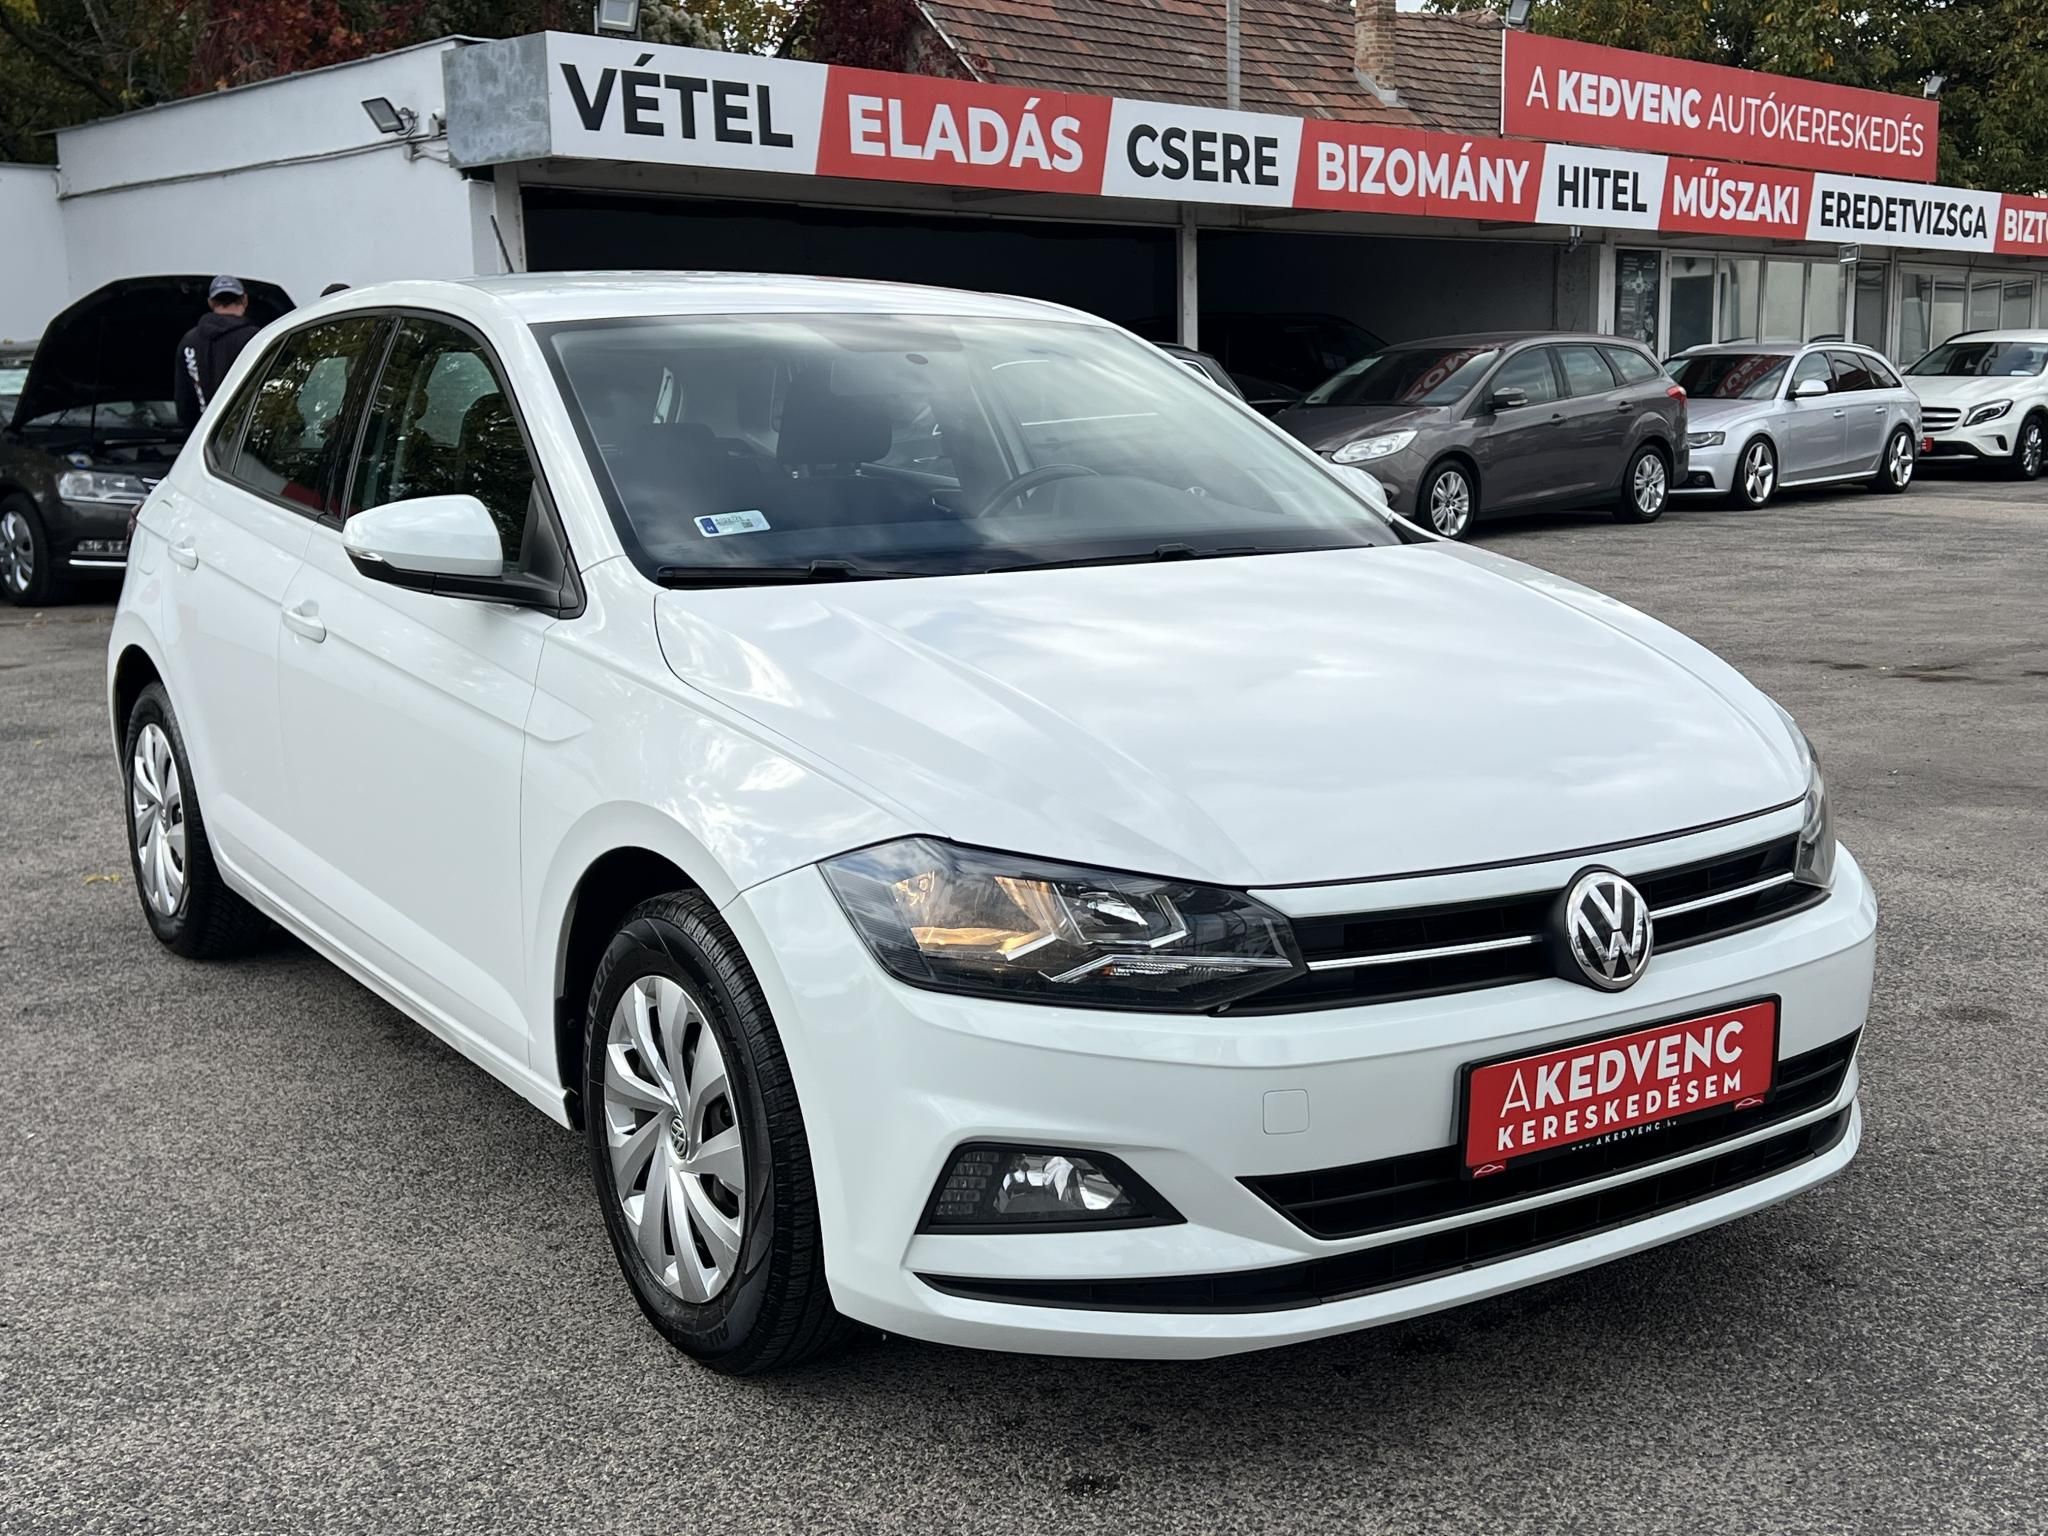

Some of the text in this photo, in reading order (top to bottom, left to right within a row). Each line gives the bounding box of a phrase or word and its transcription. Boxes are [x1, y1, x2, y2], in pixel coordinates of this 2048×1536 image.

[561, 54, 793, 148] VÉTEL
[1526, 66, 1923, 157] A KEDVENC AUTÓKERESKEDÉS
[848, 94, 1083, 172] ELADÁS
[1127, 125, 1278, 186] CSERE
[1318, 142, 1529, 204] BIZOMÁNY
[1558, 165, 1647, 212] HITEL
[1673, 168, 1799, 224] MŰSZAKI
[1821, 191, 1987, 238] EREDETVIZSGA
[2004, 209, 2048, 243] BIZT
[1498, 1070, 1740, 1150] KERESKEDÉSEM
